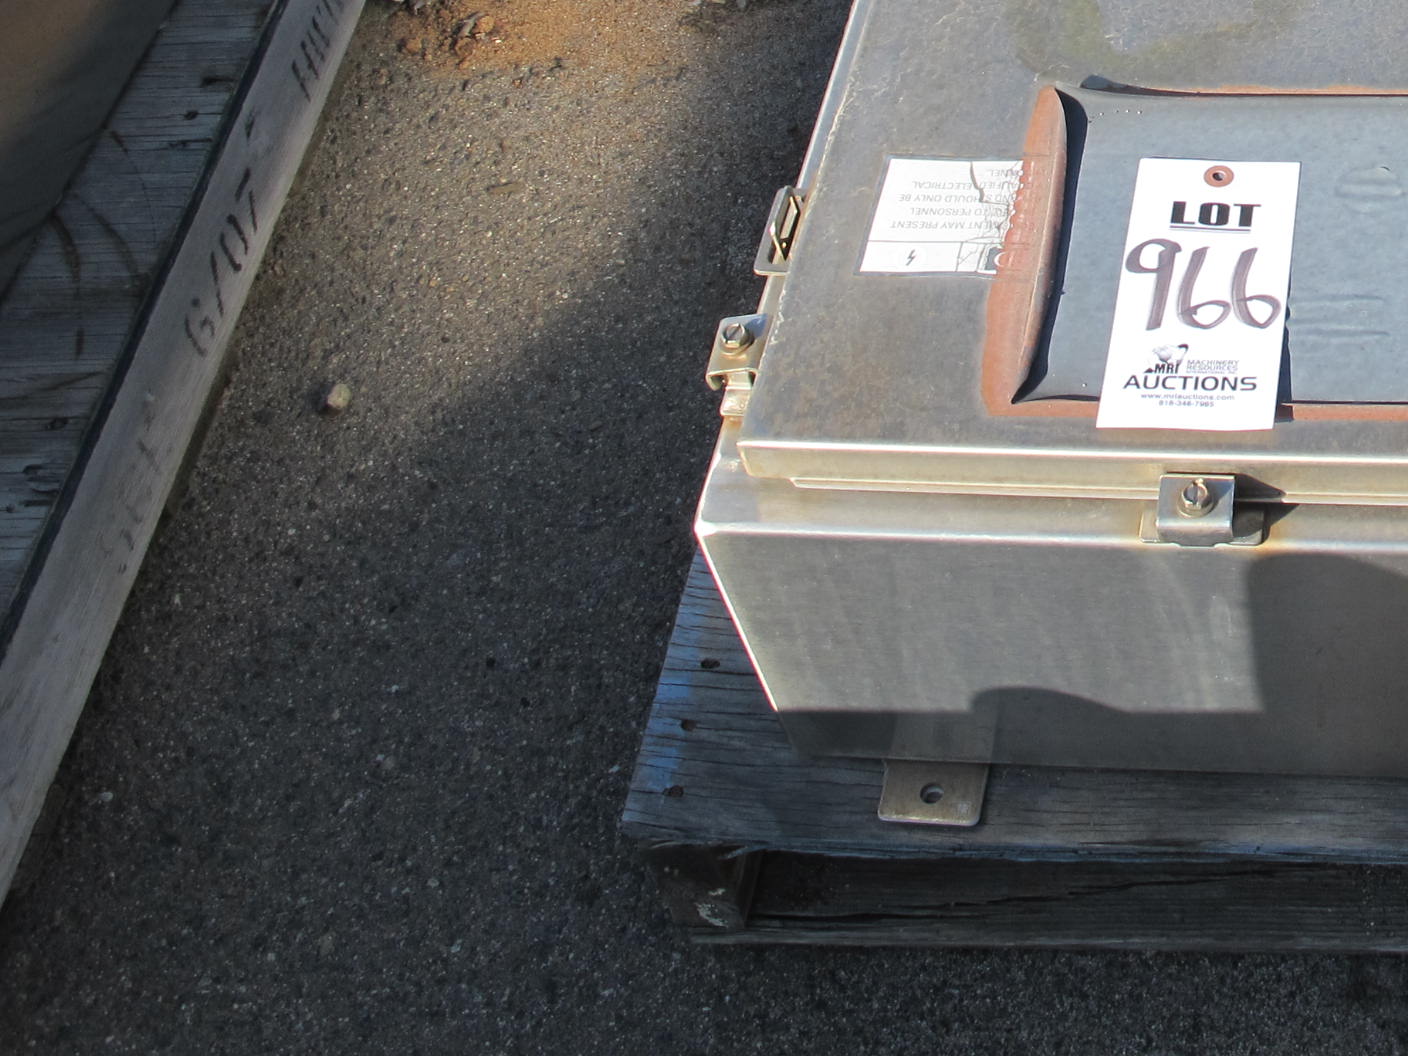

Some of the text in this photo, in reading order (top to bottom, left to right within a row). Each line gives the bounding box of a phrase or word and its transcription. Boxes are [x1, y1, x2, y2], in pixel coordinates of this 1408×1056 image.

[911, 181, 972, 191] ELECTRICAL
[897, 193, 912, 203] BE
[914, 193, 942, 203] ONLY
[909, 207, 971, 217] PERSONNEL
[1170, 201, 1261, 227] LOT
[889, 220, 938, 230] PRESENT
[940, 220, 966, 230] MAY
[1125, 238, 1281, 331] 966
[1154, 360, 1182, 374] MRI
[1123, 374, 1258, 391] AUCTIONS
